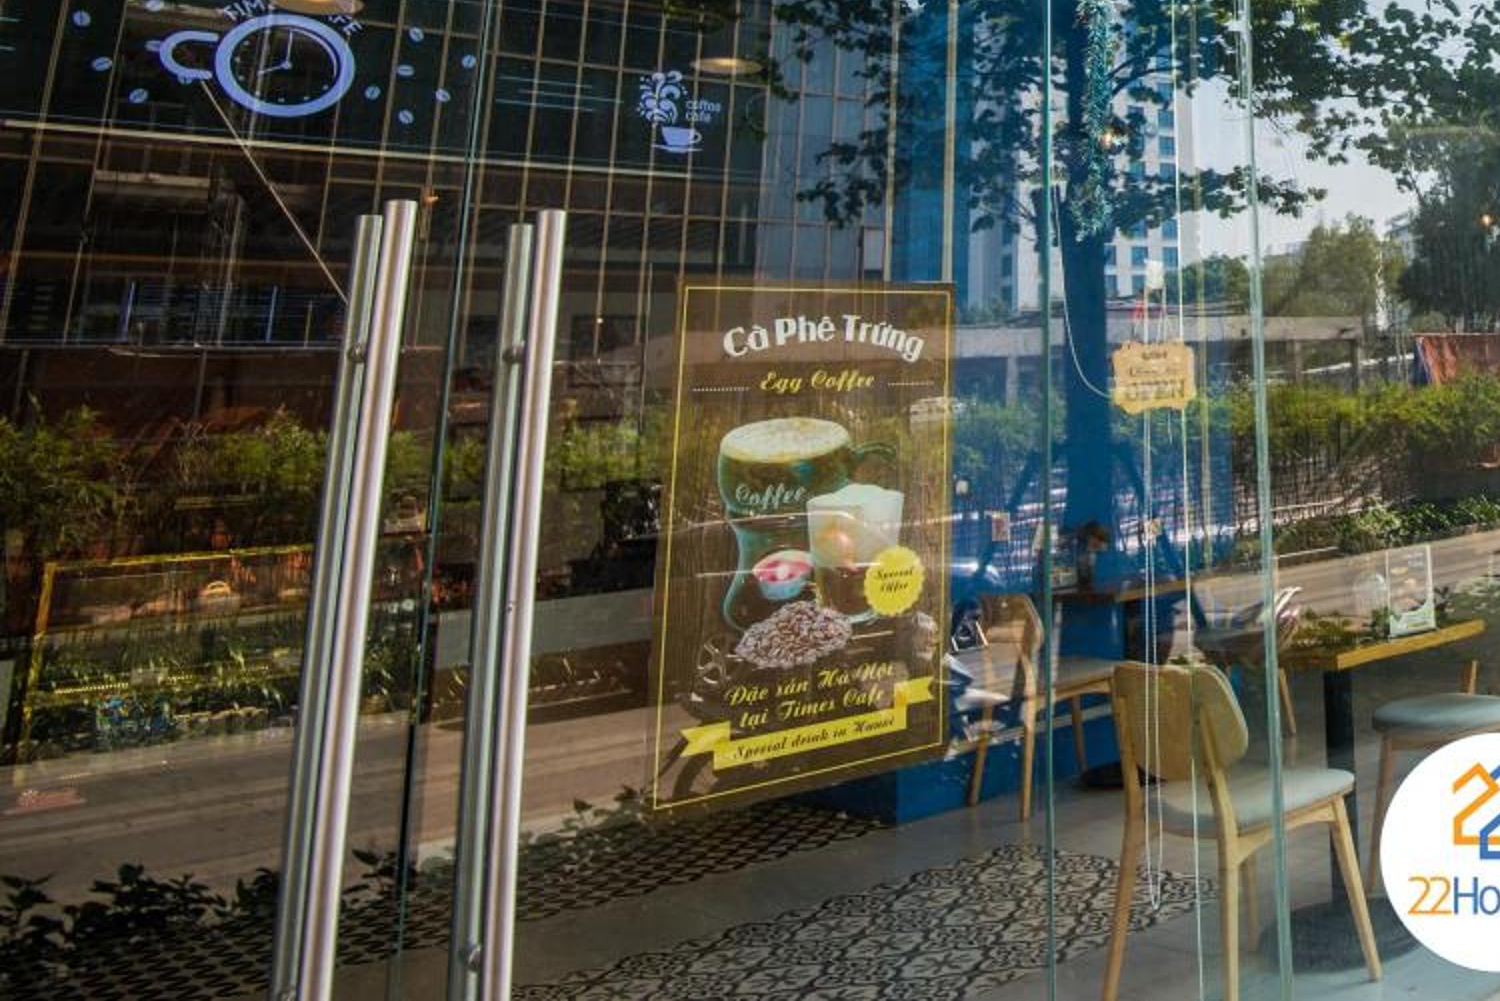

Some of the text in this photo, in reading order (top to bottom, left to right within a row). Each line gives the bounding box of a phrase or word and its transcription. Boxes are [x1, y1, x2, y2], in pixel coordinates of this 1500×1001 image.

[723, 314, 925, 363] Cà Phê Trứng
[760, 369, 876, 394] Egg Coffee
[735, 483, 807, 510] Coffee
[778, 698, 836, 720] Times
